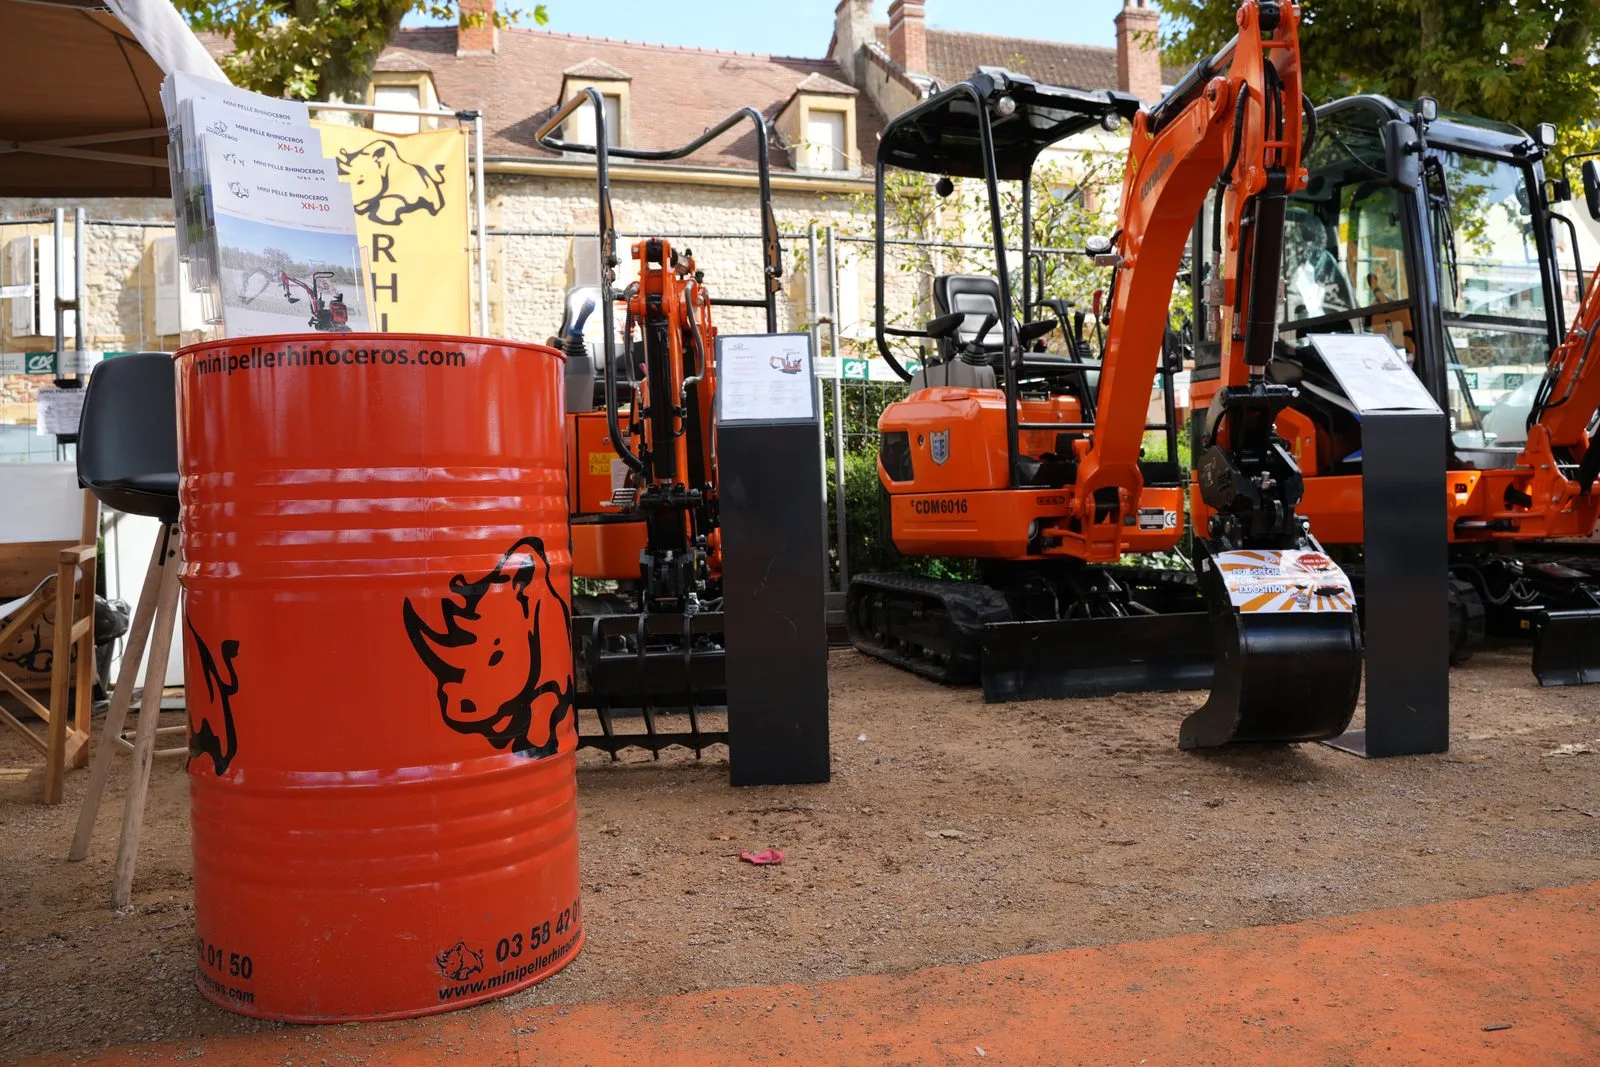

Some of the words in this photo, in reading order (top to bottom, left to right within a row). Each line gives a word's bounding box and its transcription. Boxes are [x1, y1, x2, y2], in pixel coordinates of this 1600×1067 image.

[223, 99, 237, 108] MINI
[237, 103, 253, 113] PELLE
[253, 107, 292, 120] RHINOCEROS
[235, 124, 248, 132] MINI
[249, 128, 265, 137] PELLE
[266, 132, 304, 144] RHINOCEROS
[277, 142, 305, 154] XN-16
[253, 159, 266, 167] MINI
[267, 162, 284, 171] PELLE
[284, 166, 325, 175] RHINOCEROS
[256, 185, 270, 193] MINI
[271, 188, 288, 197] PELLE
[288, 192, 329, 202] RHINOCEROS
[300, 201, 330, 212] XN-10
[195, 345, 466, 377] minipellerhinoceros.com
[915, 498, 968, 515] CDM6016
[1251, 565, 1282, 576] SPÉCIA
[1238, 584, 1288, 594] EXPOSITION
[496, 933, 523, 963] 03
[529, 920, 550, 951] 58
[555, 906, 570, 936] 42
[207, 943, 223, 972] 01
[229, 952, 253, 980] 50
